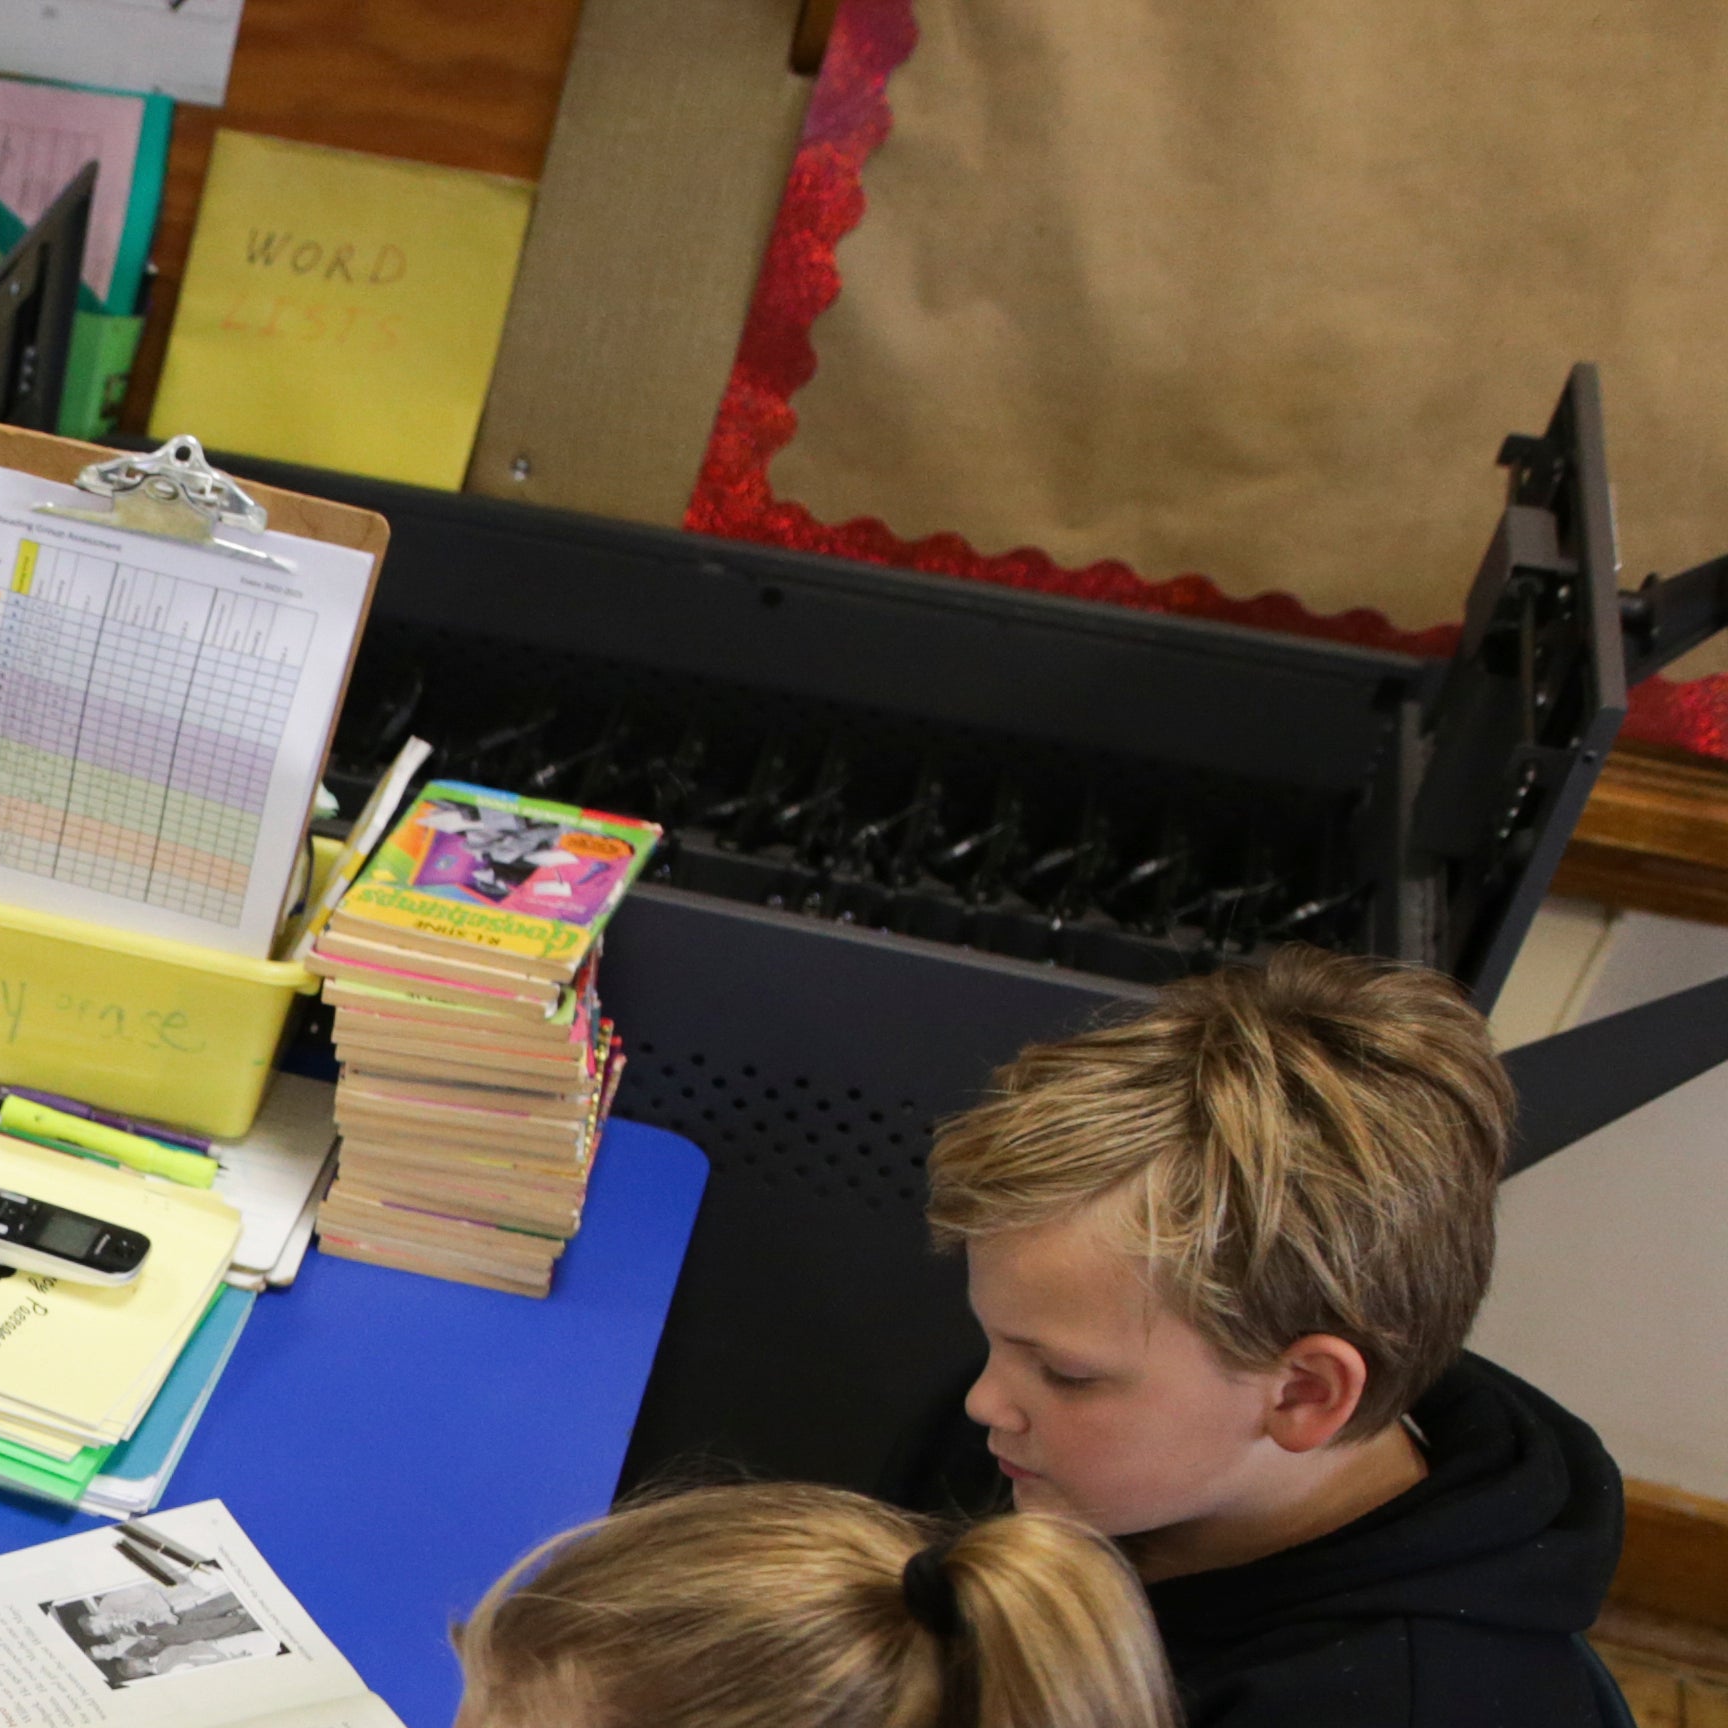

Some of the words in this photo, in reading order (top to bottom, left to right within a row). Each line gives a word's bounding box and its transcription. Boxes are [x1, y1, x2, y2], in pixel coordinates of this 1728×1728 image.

[247, 228, 408, 284] WORD
[219, 292, 404, 350] LISTS
[357, 885, 579, 956] Goosebumps
